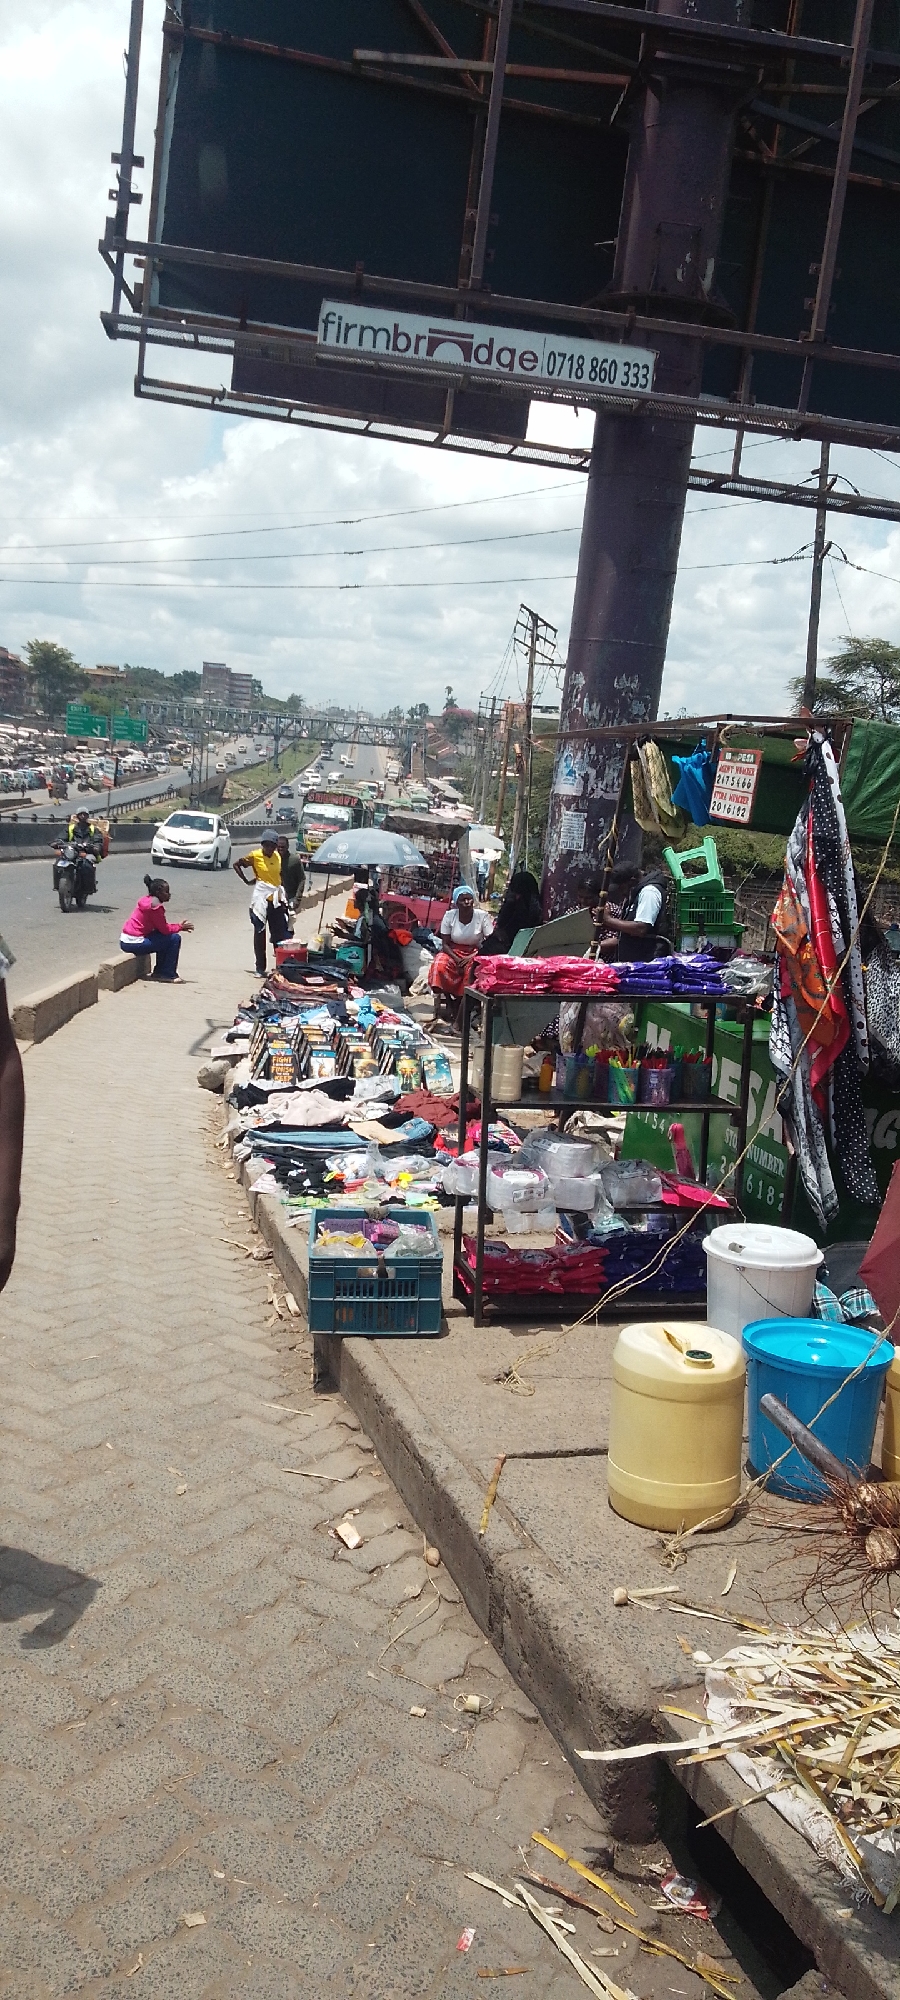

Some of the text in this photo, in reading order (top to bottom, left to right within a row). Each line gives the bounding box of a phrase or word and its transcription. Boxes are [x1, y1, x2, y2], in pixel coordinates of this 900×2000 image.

[320, 311, 539, 372] firmbrdge
[546, 350, 649, 390] 0718 860 333
[725, 1127, 785, 1178] STO NUMBER
